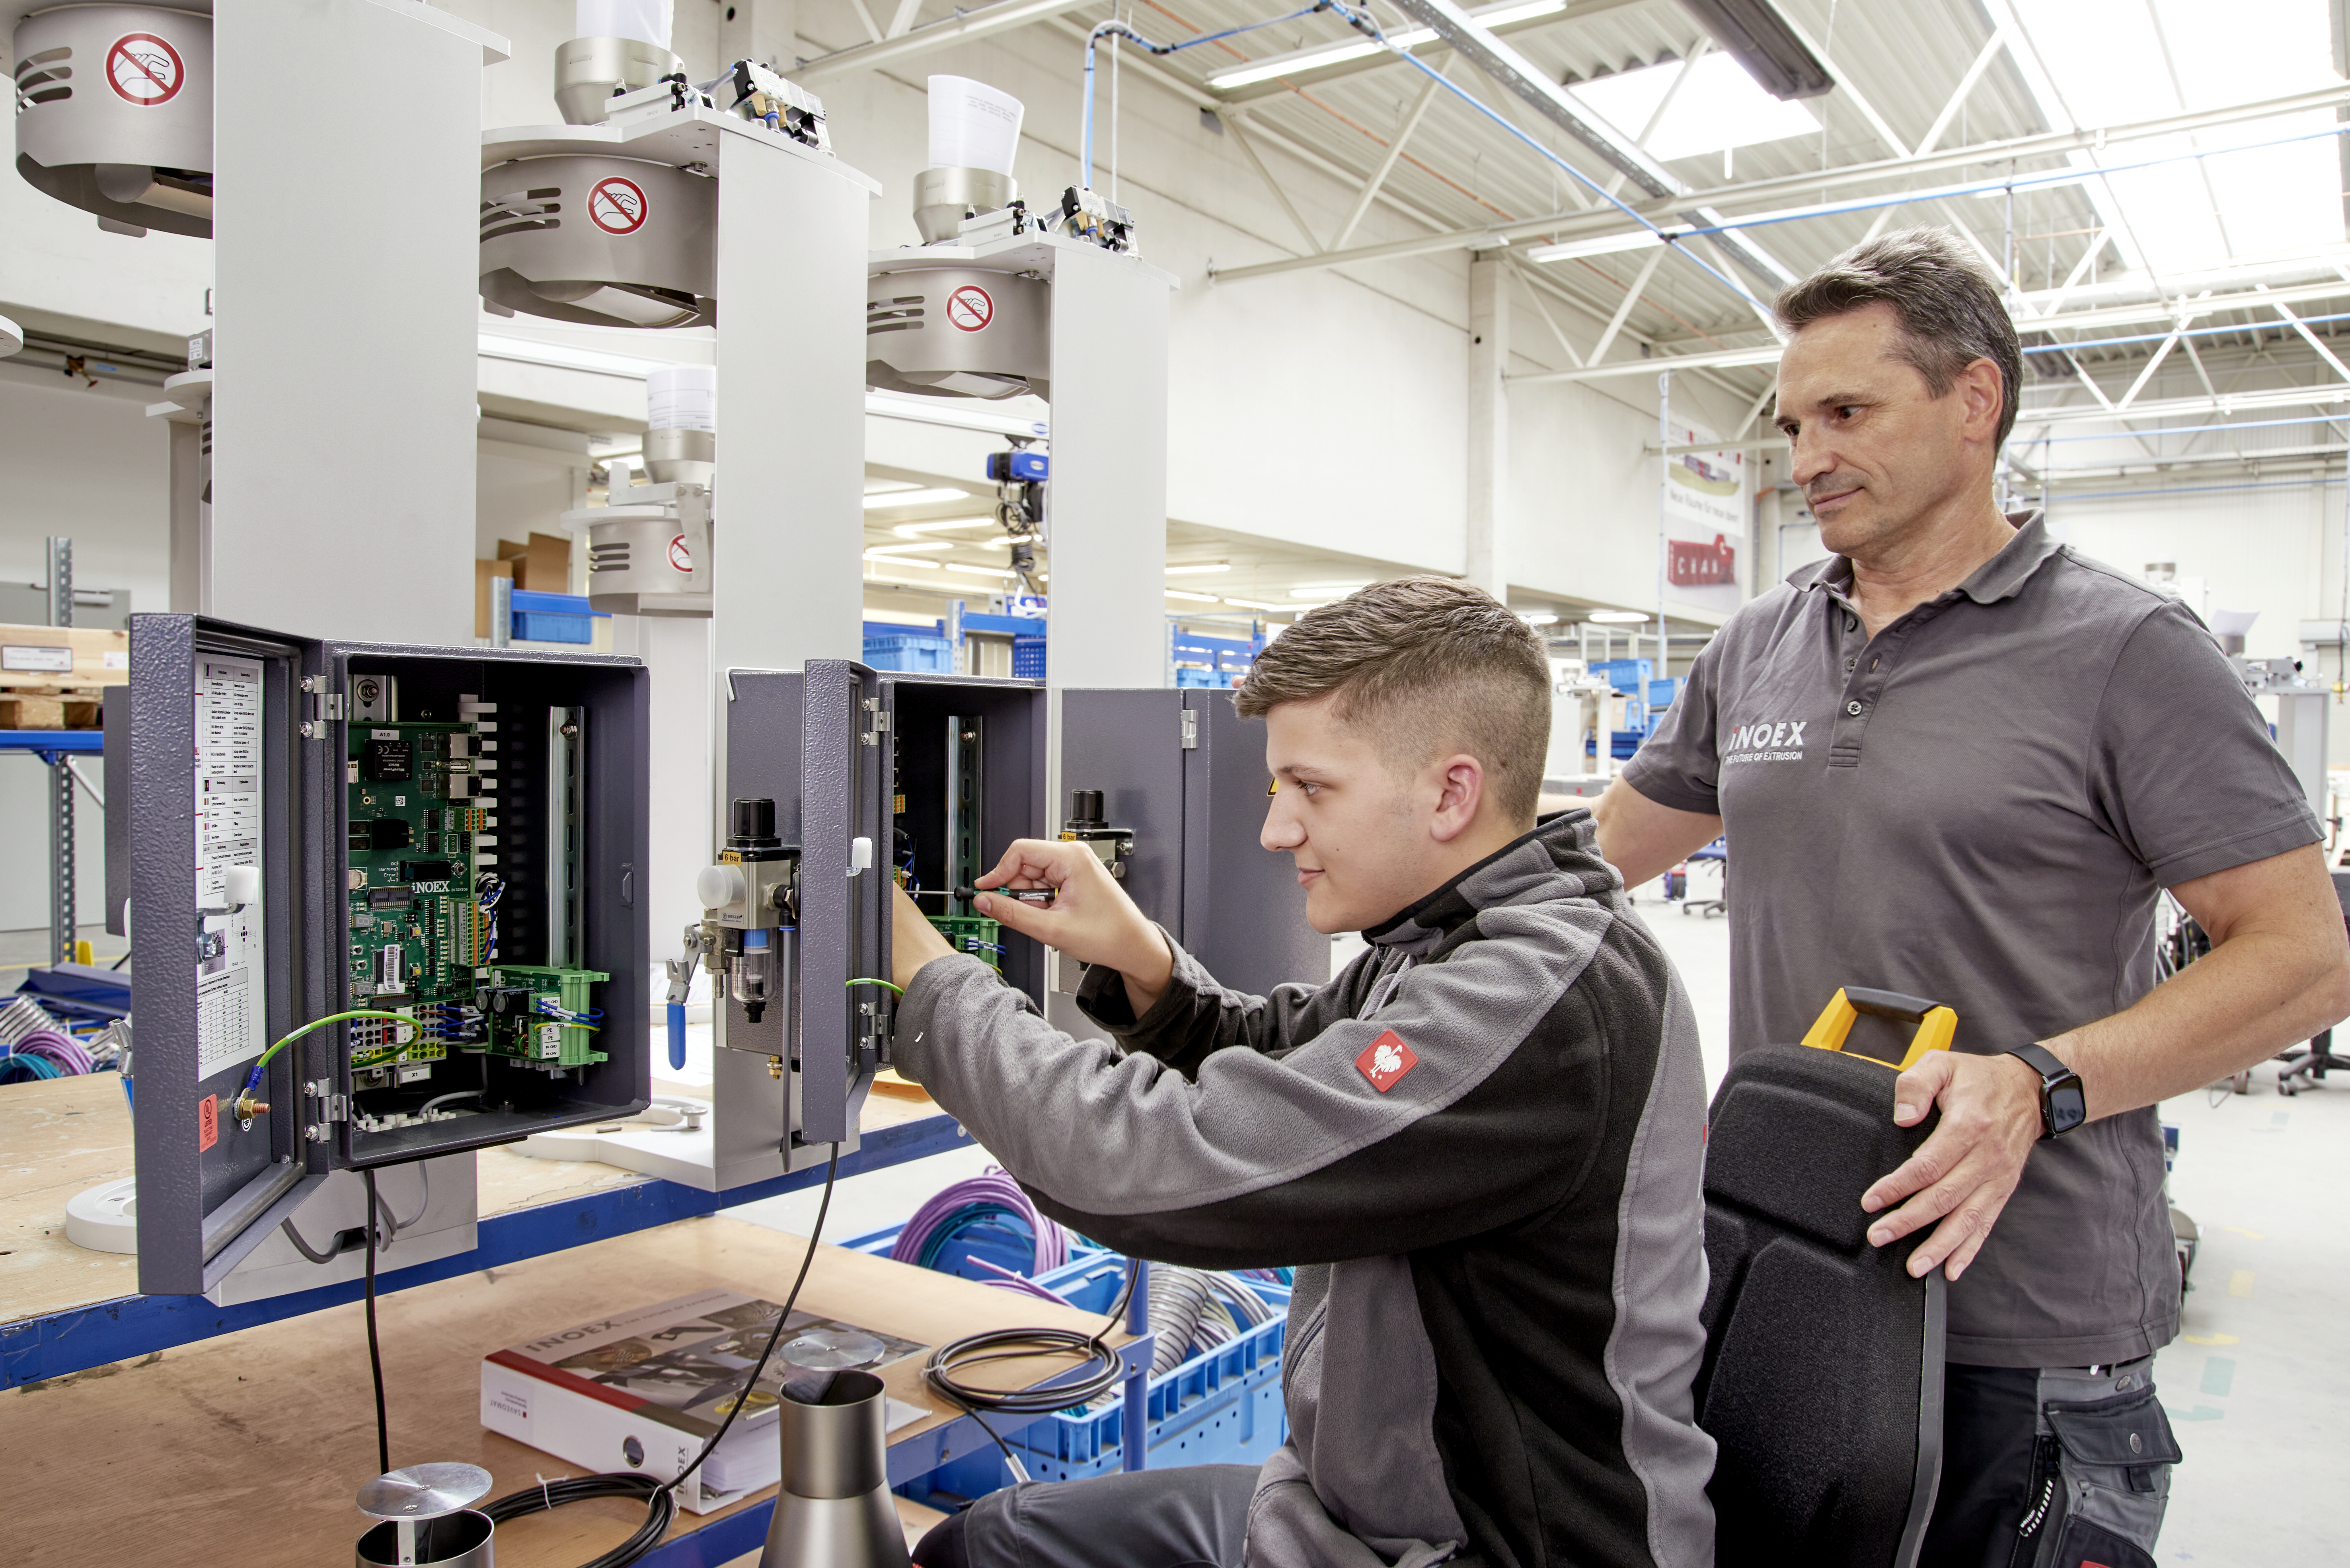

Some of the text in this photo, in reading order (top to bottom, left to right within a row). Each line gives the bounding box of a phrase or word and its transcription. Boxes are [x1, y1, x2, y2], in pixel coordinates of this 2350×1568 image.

[1728, 721, 1807, 750] iNOEX
[1734, 753, 1754, 763] FUTURE
[1754, 753, 1763, 761] OF
[1763, 751, 1802, 761] EXTRUSION
[411, 880, 450, 894] iNOEX
[526, 1321, 622, 1352] iNOEX
[677, 1446, 686, 1494] iOEX
